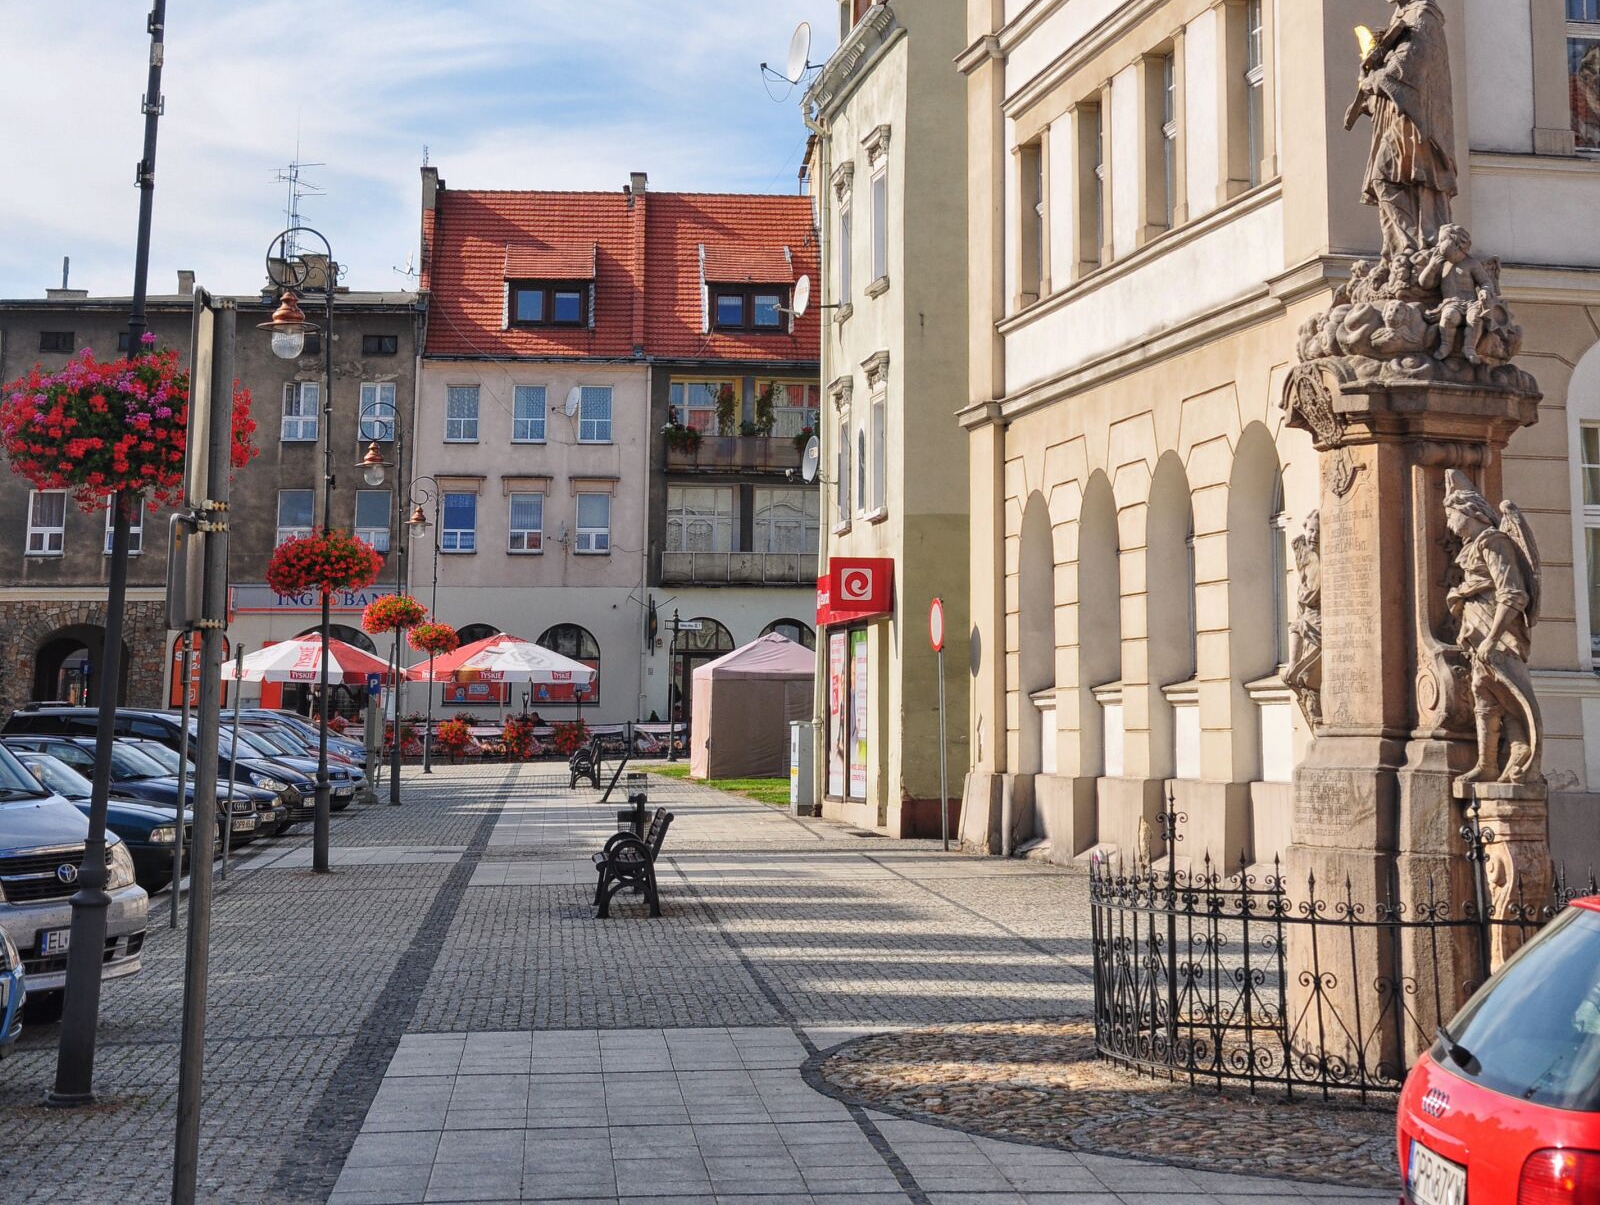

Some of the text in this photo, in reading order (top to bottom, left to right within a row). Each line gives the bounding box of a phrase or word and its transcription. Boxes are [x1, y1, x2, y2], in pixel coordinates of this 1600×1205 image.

[277, 593, 312, 606] ING
[291, 671, 315, 679] TYSKIE
[480, 671, 502, 679] TYSKIE
[552, 671, 571, 680] TYSKIE
[370, 679, 378, 689] P
